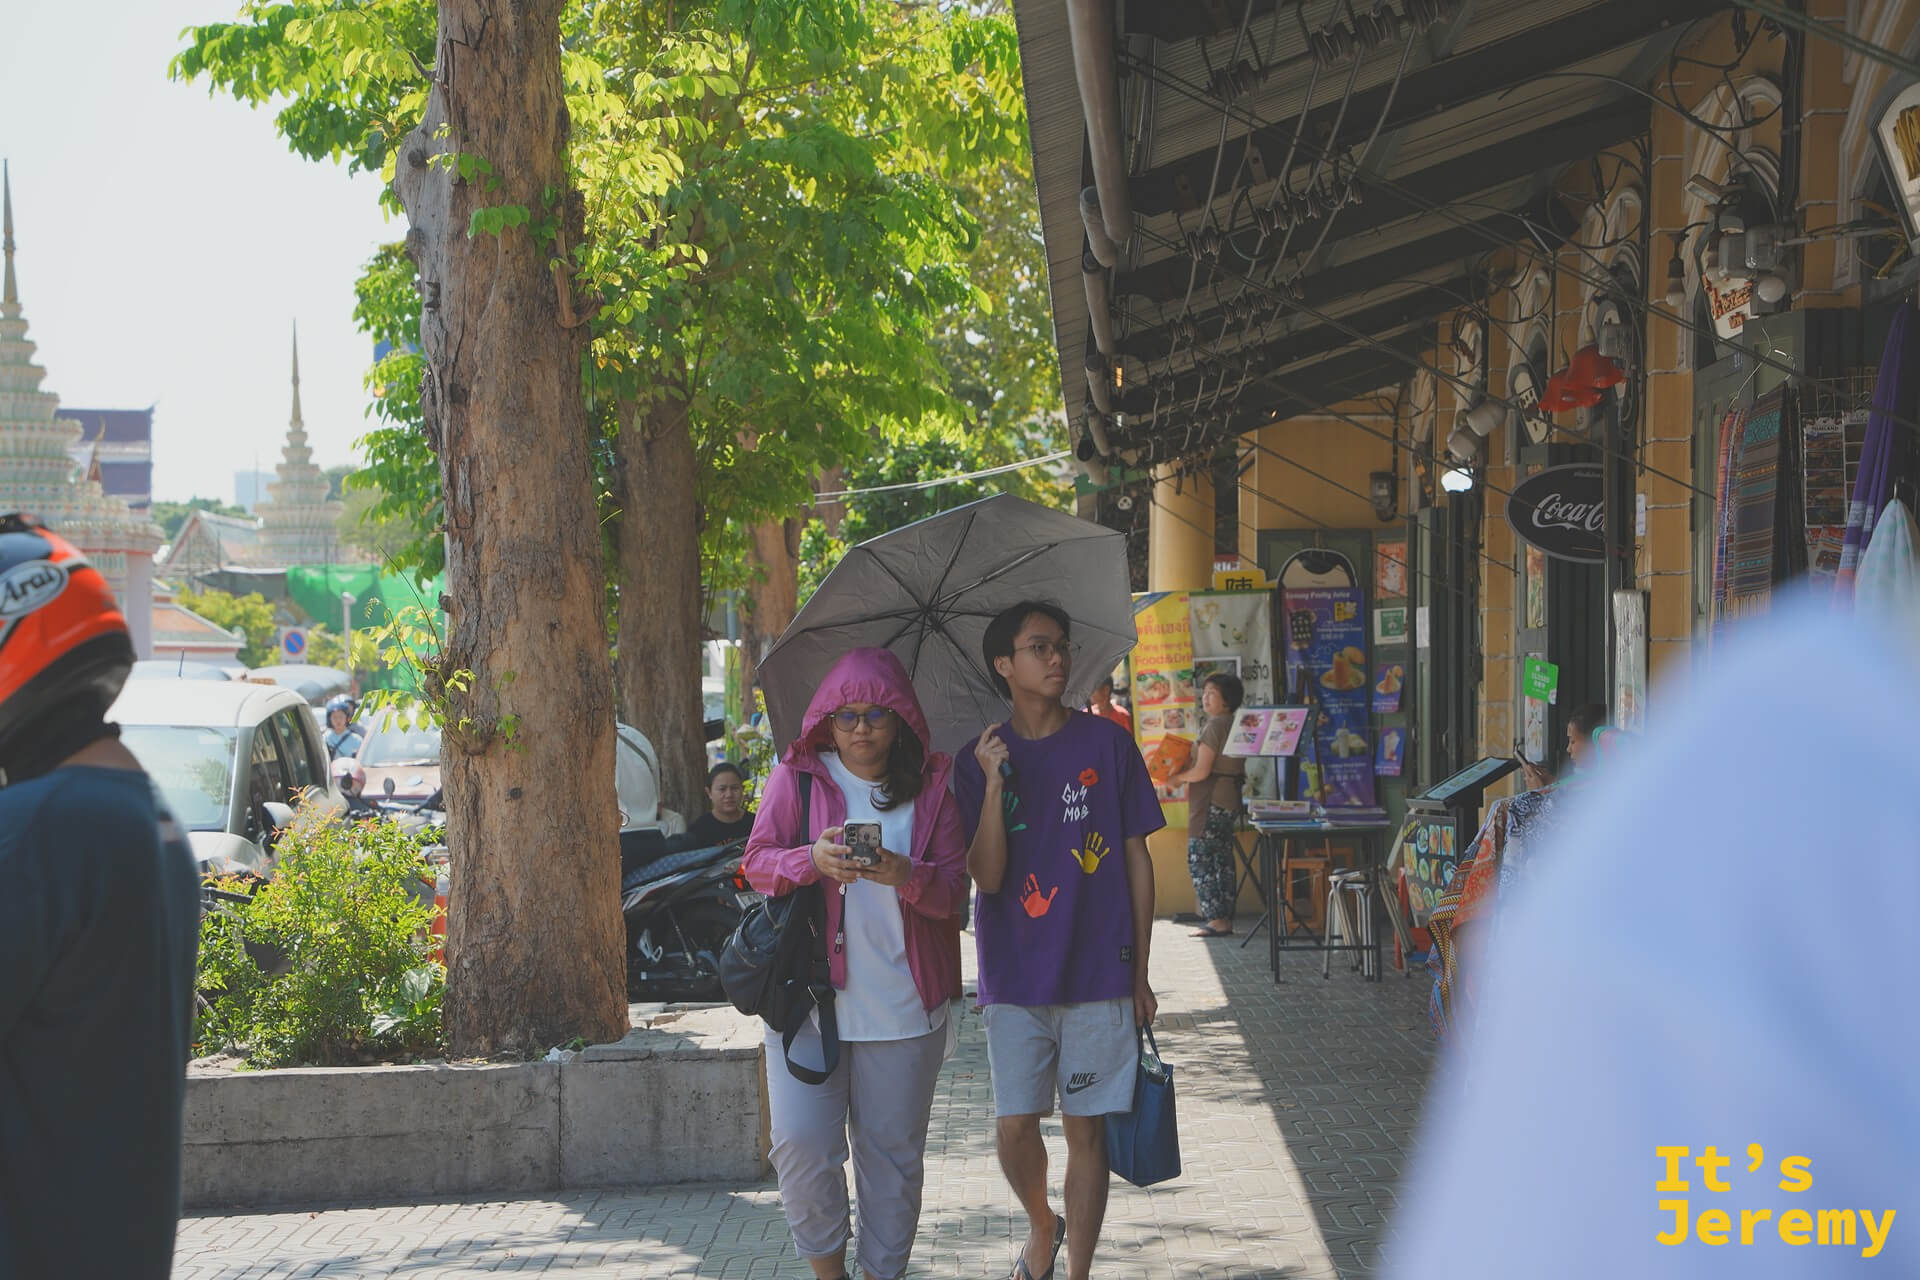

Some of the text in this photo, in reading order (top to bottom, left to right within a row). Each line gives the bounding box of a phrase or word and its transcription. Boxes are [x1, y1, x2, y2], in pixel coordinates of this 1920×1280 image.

[1, 564, 56, 611] Arai
[1063, 804, 1089, 823] MOB
[1070, 1072, 1097, 1085] NIKE
